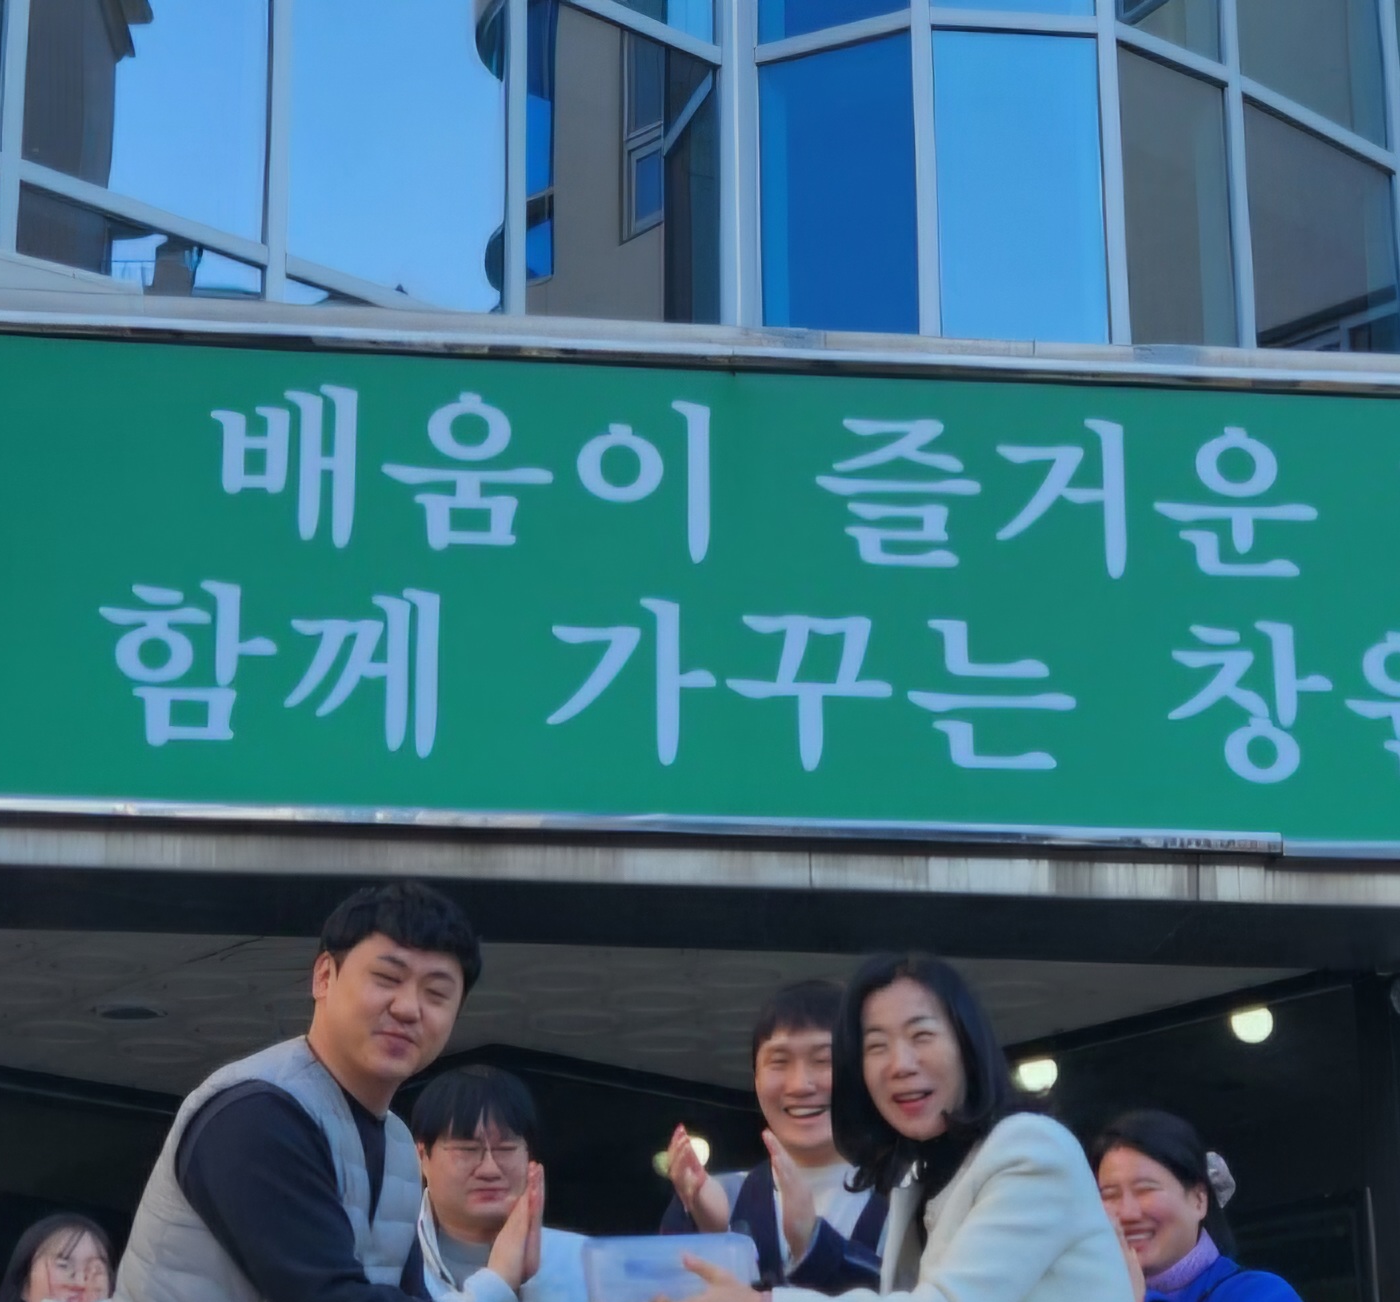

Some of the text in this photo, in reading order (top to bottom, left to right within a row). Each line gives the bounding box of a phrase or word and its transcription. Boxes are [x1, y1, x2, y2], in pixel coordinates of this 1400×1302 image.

[210, 384, 711, 564] 배움이
[815, 418, 1319, 579] 즐거운
[98, 580, 441, 759] 함께
[546, 597, 1077, 772] 가꾸는
